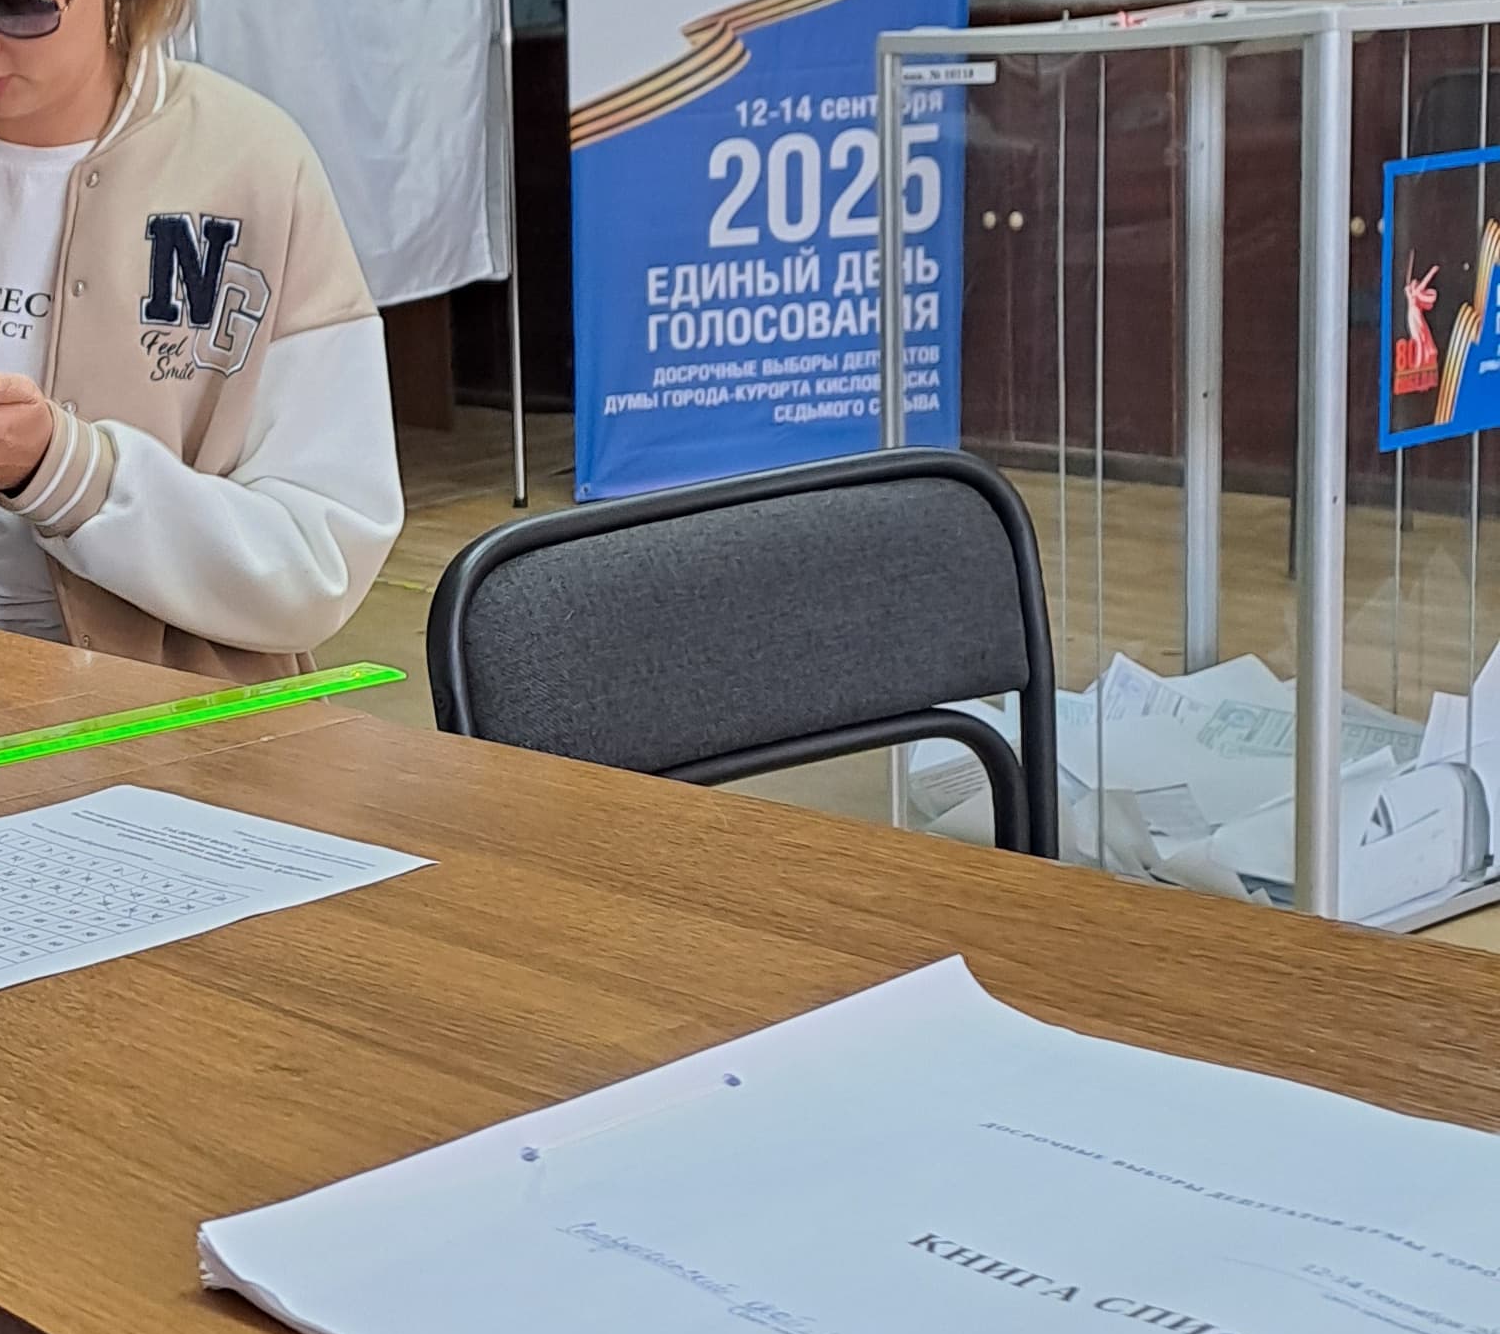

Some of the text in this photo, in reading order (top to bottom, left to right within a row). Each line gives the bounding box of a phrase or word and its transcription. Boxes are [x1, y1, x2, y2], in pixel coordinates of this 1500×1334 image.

[735, 89, 944, 128] 12-14 сентря
[707, 123, 942, 249] 2025
[647, 245, 821, 310] ЕДИНЫЙ
[140, 329, 188, 357] Feel
[150, 355, 196, 382] Smile
[652, 345, 941, 388] ДОСРОЧНЫЕ ВЫБОРЫ ДЕПТОВ
[603, 369, 940, 416] ДУМЫ ГОРОДА-КУРОРТА КИСЛОВСКА
[773, 392, 941, 424] СЕДЬМОГО СЫВА
[907, 1231, 1081, 1303] КНИГА
